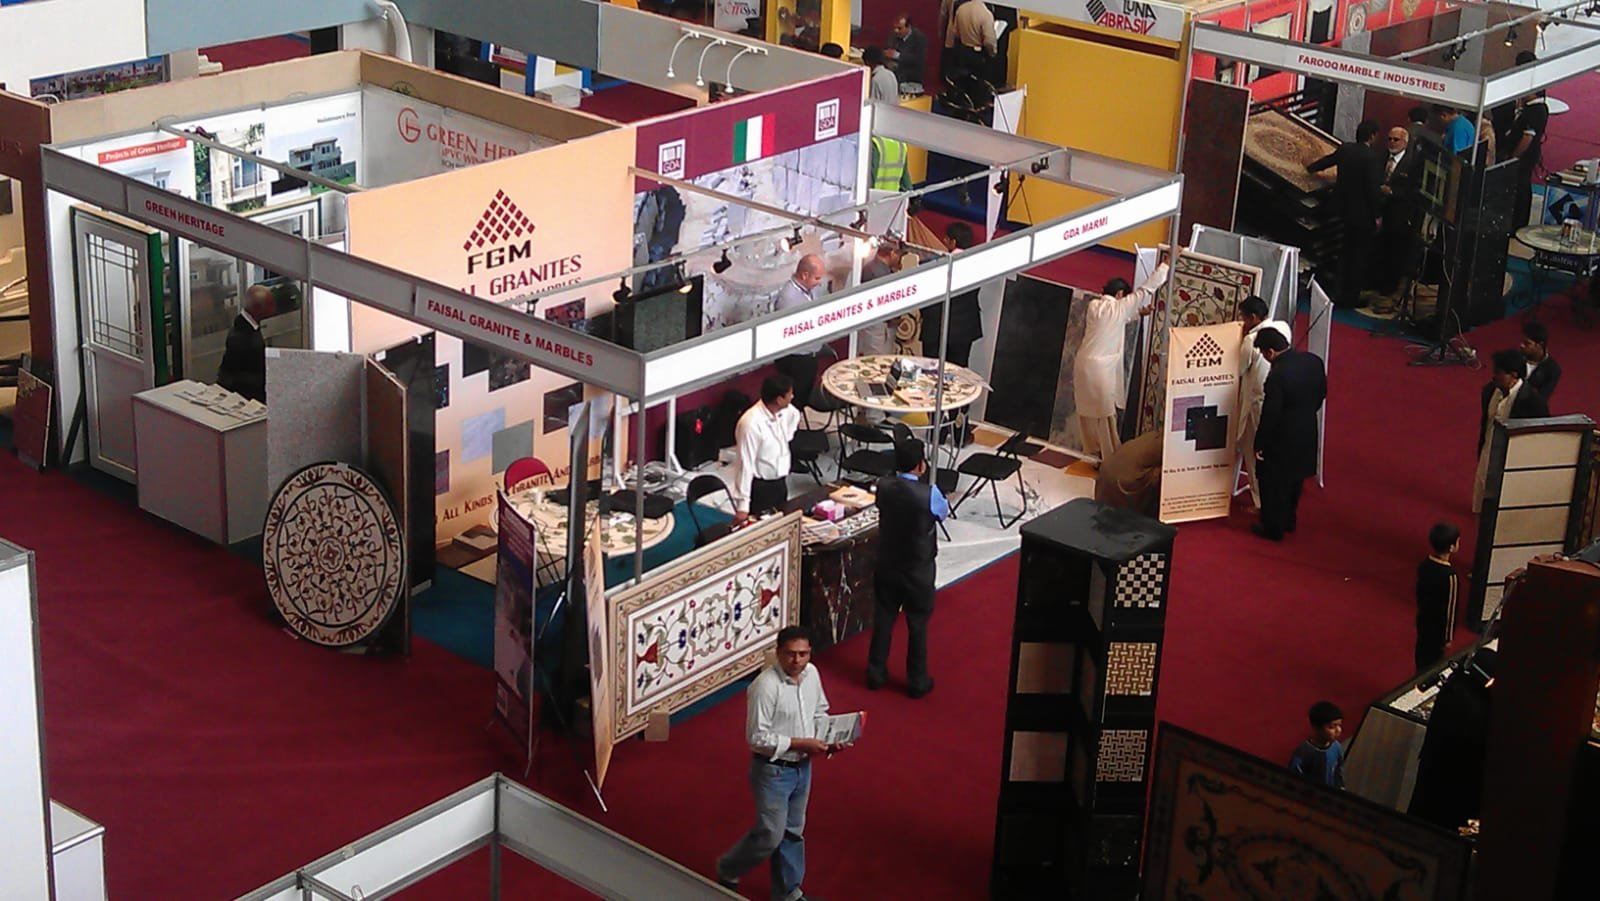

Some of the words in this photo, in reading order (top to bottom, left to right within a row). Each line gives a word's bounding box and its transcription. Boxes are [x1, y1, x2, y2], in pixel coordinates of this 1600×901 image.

[1096, 12, 1156, 35] ABRASIV
[1123, 0, 1157, 20] LUNA
[1339, 63, 1381, 79] MARBLE
[1384, 72, 1445, 92] INDUSTRIES
[138, 144, 157, 155] Green
[427, 123, 478, 154] GREEN
[663, 160, 681, 173] GDA
[145, 200, 177, 221] GREEN
[177, 208, 225, 237] HERITAGE
[1063, 227, 1080, 240] GDA
[1081, 215, 1108, 234] MARMI
[467, 239, 532, 275] FGM
[490, 254, 582, 296] GRANITES
[783, 319, 815, 338] FAISAL
[817, 302, 863, 327] GRANITES
[866, 299, 874, 311] &
[876, 284, 918, 307] MARBLES
[427, 299, 466, 323] FAISAL
[469, 314, 520, 343] GRANITE
[523, 333, 532, 345] &
[535, 336, 594, 367] MARBLES
[1186, 356, 1222, 369] FGM
